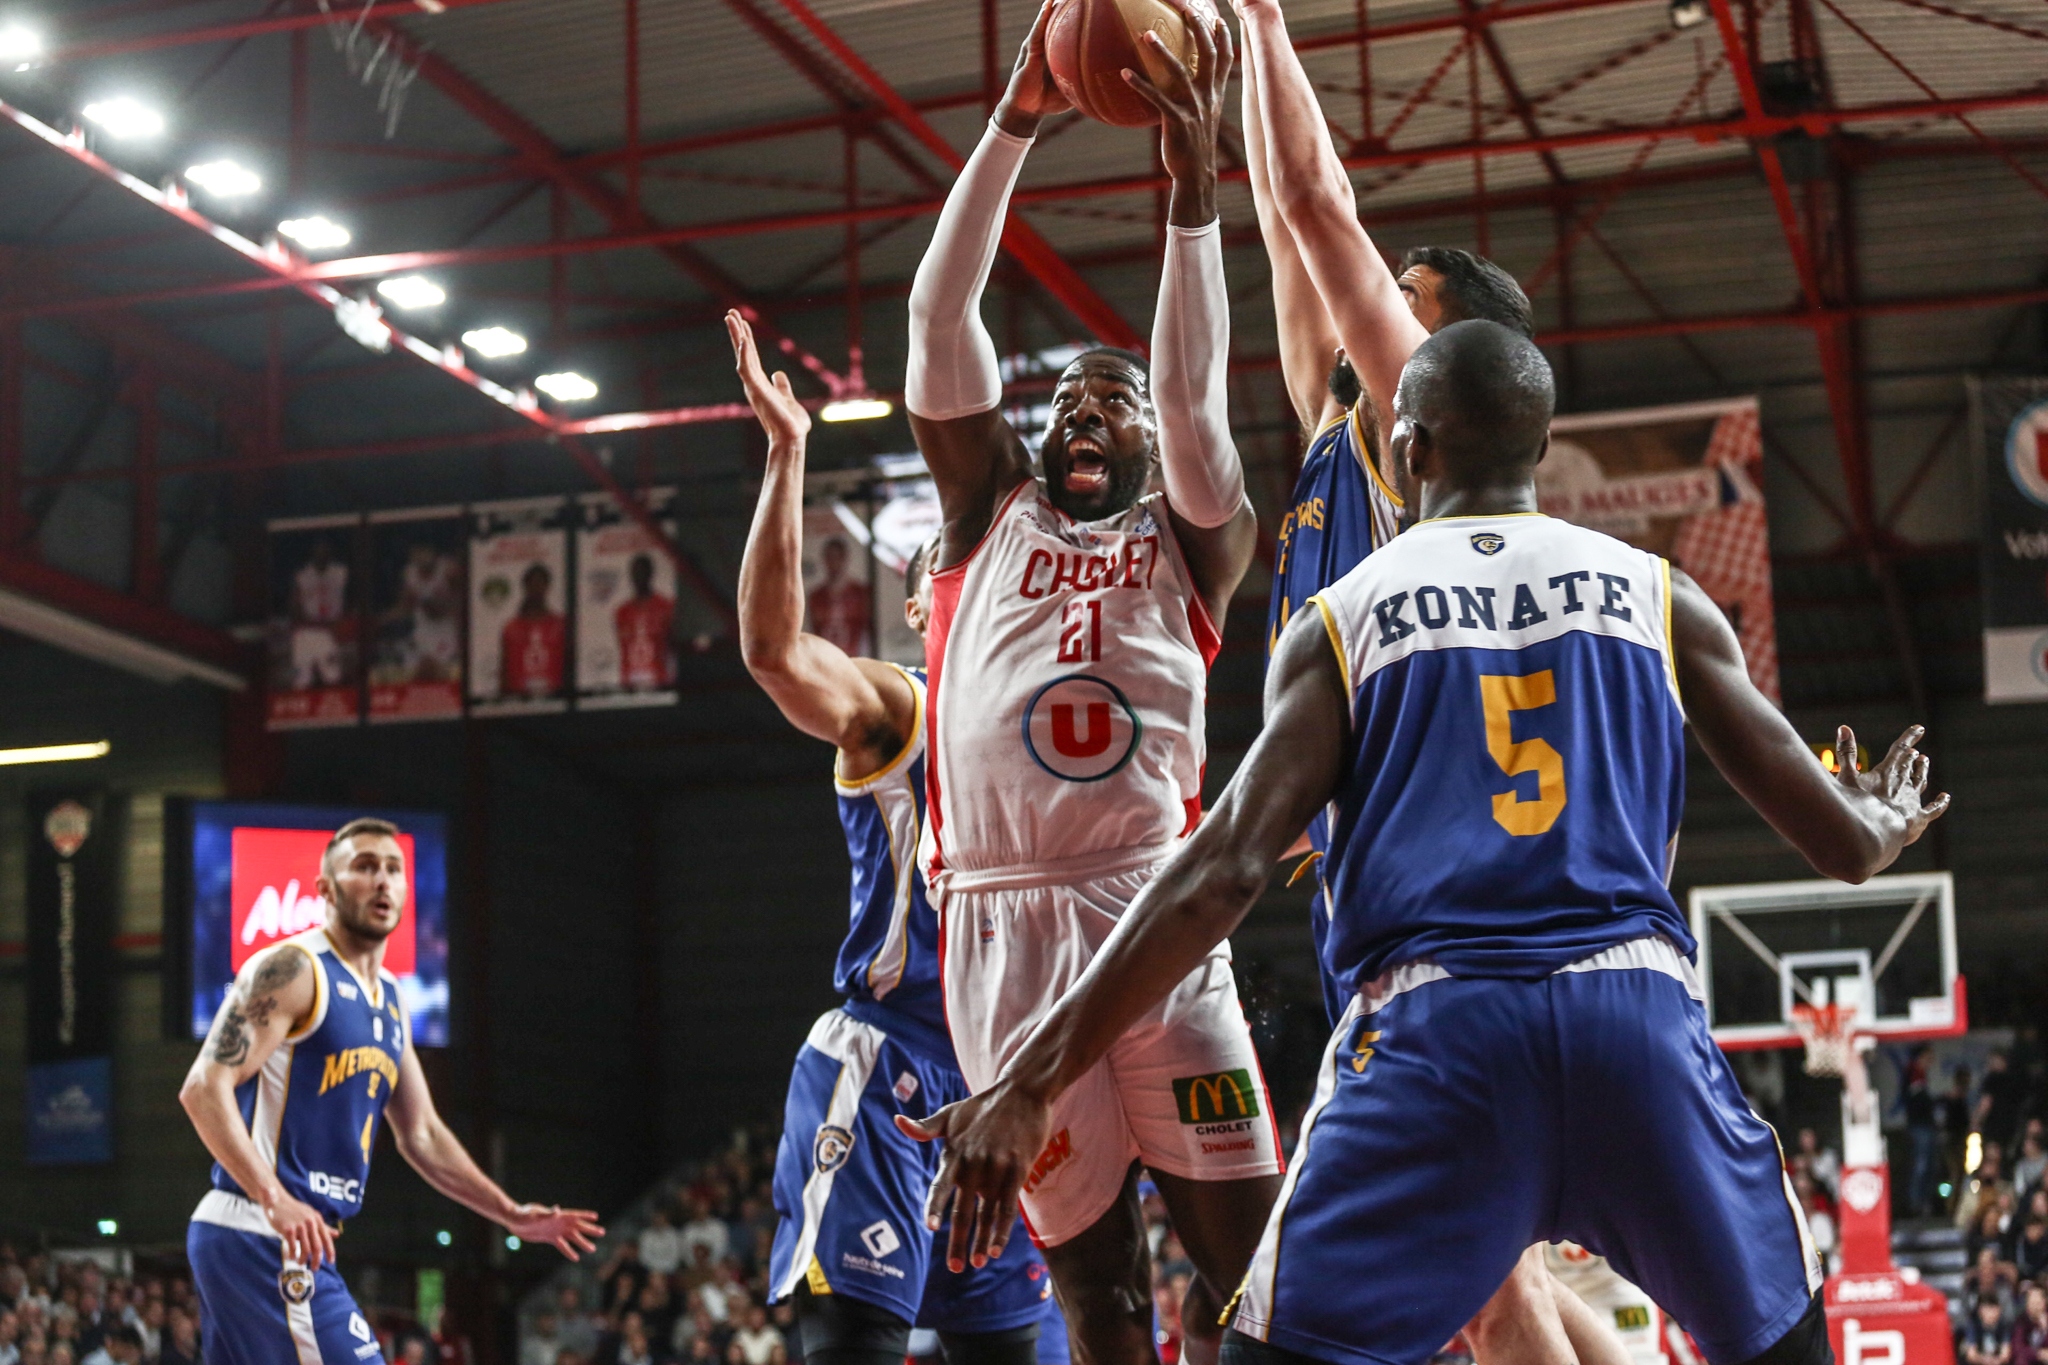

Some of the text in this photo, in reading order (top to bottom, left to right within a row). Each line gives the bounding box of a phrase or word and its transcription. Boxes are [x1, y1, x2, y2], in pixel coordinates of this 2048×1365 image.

[1019, 535, 1159, 600] CHOLET
[1056, 600, 1102, 663] 21
[1372, 570, 1632, 649] KONATE
[1051, 702, 1112, 758] U
[1479, 669, 1567, 836] 5
[1351, 1030, 1382, 1073] 5
[1195, 1120, 1253, 1136] CHOLET
[1201, 1138, 1255, 1155] SPALDING
